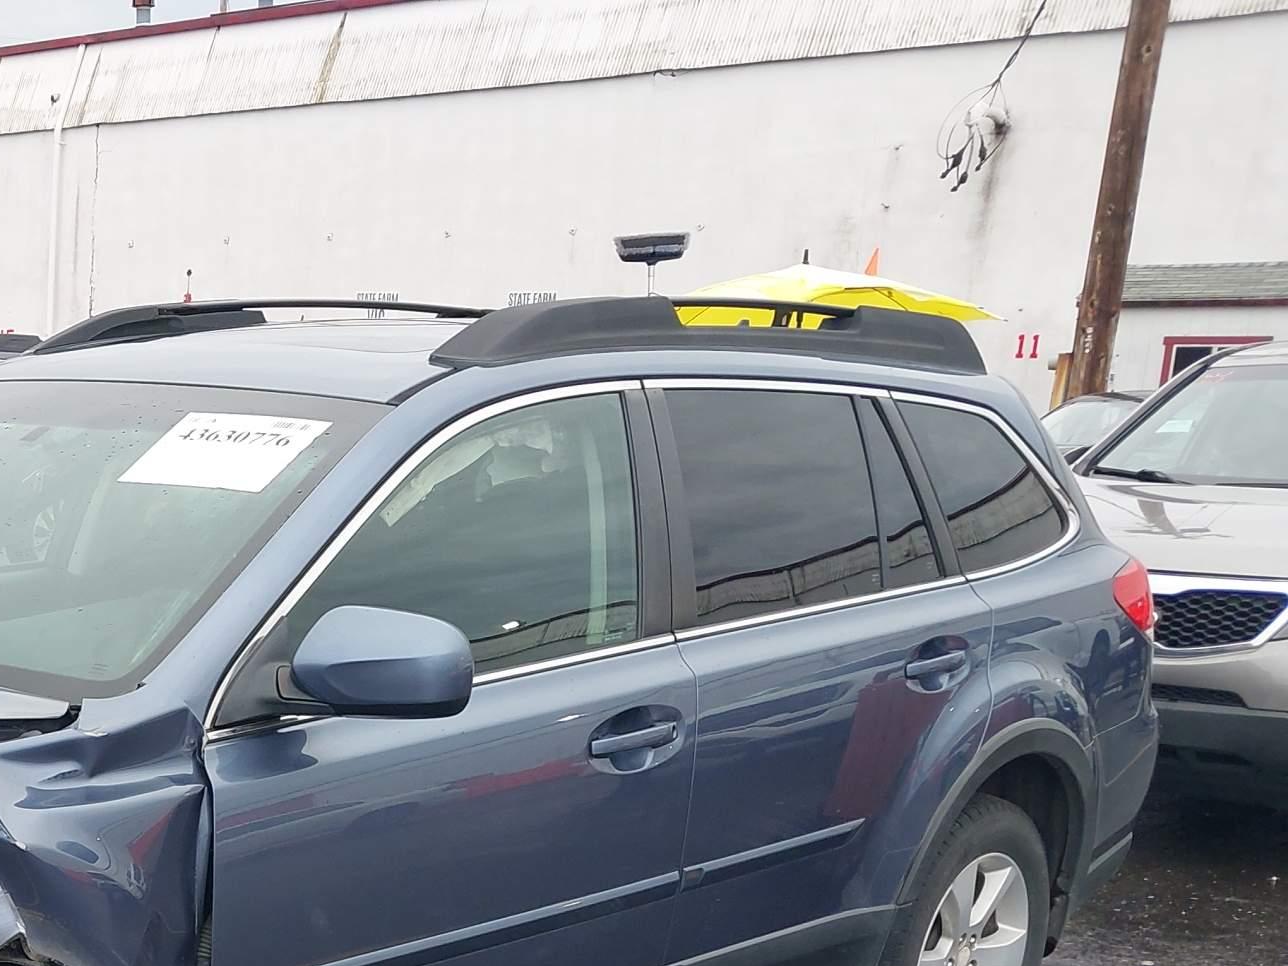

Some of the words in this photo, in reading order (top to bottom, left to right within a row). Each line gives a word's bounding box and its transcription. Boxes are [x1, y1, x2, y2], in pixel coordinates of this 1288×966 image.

[507, 292, 531, 307] STATE
[532, 291, 557, 304] FARM
[1015, 334, 1040, 359] 11
[178, 428, 292, 447] 43630776
